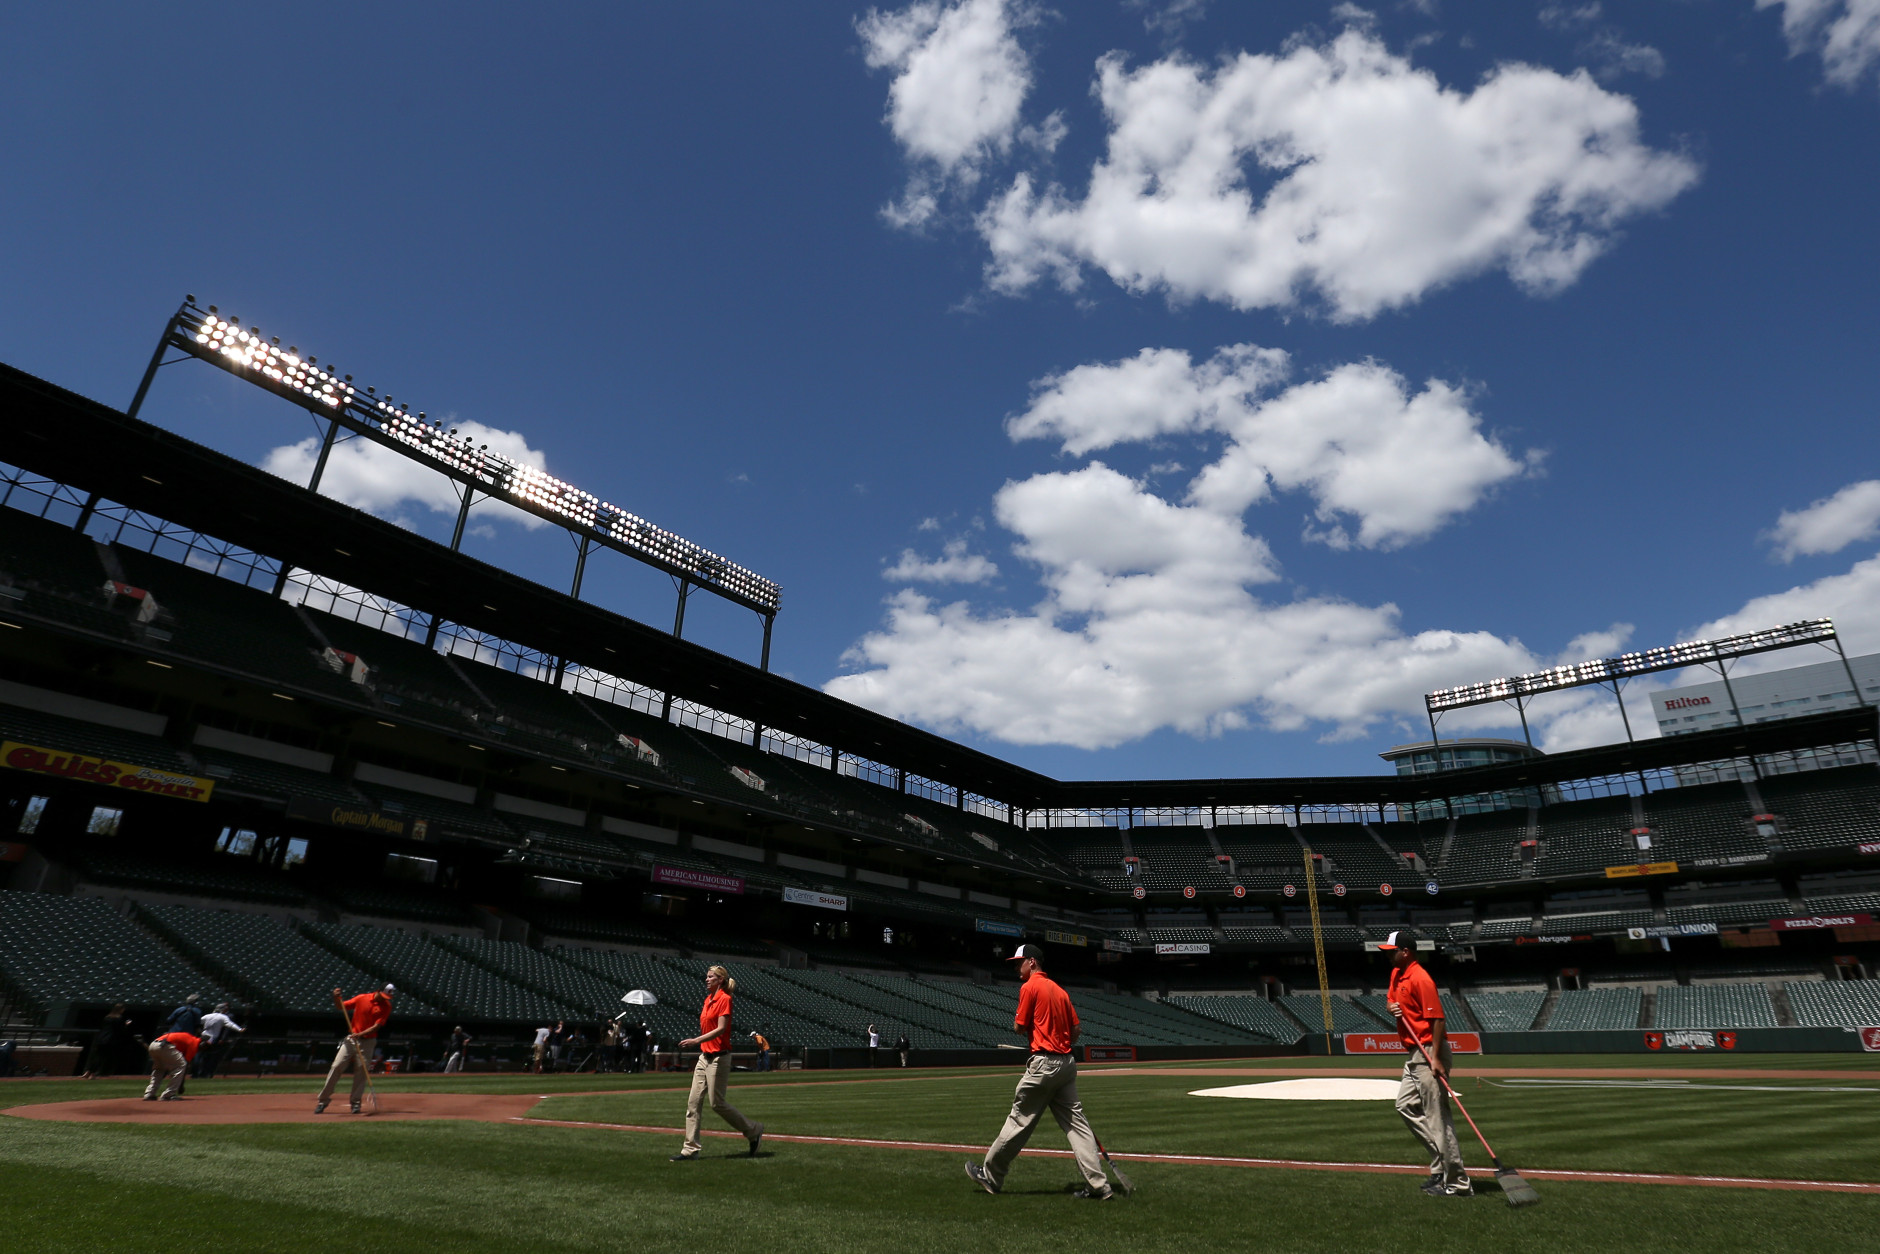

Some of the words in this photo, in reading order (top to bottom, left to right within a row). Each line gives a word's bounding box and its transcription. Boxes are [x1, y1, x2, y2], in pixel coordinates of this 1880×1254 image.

[1665, 696, 1711, 710] Hilton
[136, 768, 196, 787] Bargain
[119, 774, 205, 799] OUTLET
[331, 807, 368, 826] Captain
[365, 812, 404, 834] Morgan
[1728, 854, 1768, 863] BARBERSHOP
[659, 868, 697, 880] AMERICAN
[698, 874, 740, 887] LIMOUSINES
[819, 896, 845, 906] SHARP
[1681, 923, 1717, 934] UNION
[1784, 919, 1814, 928] PIZZA
[1048, 930, 1060, 942] RIDE
[1156, 943, 1177, 954] Live!
[1177, 944, 1209, 952] CASINO
[1665, 1033, 1715, 1047] CHAMPIONS
